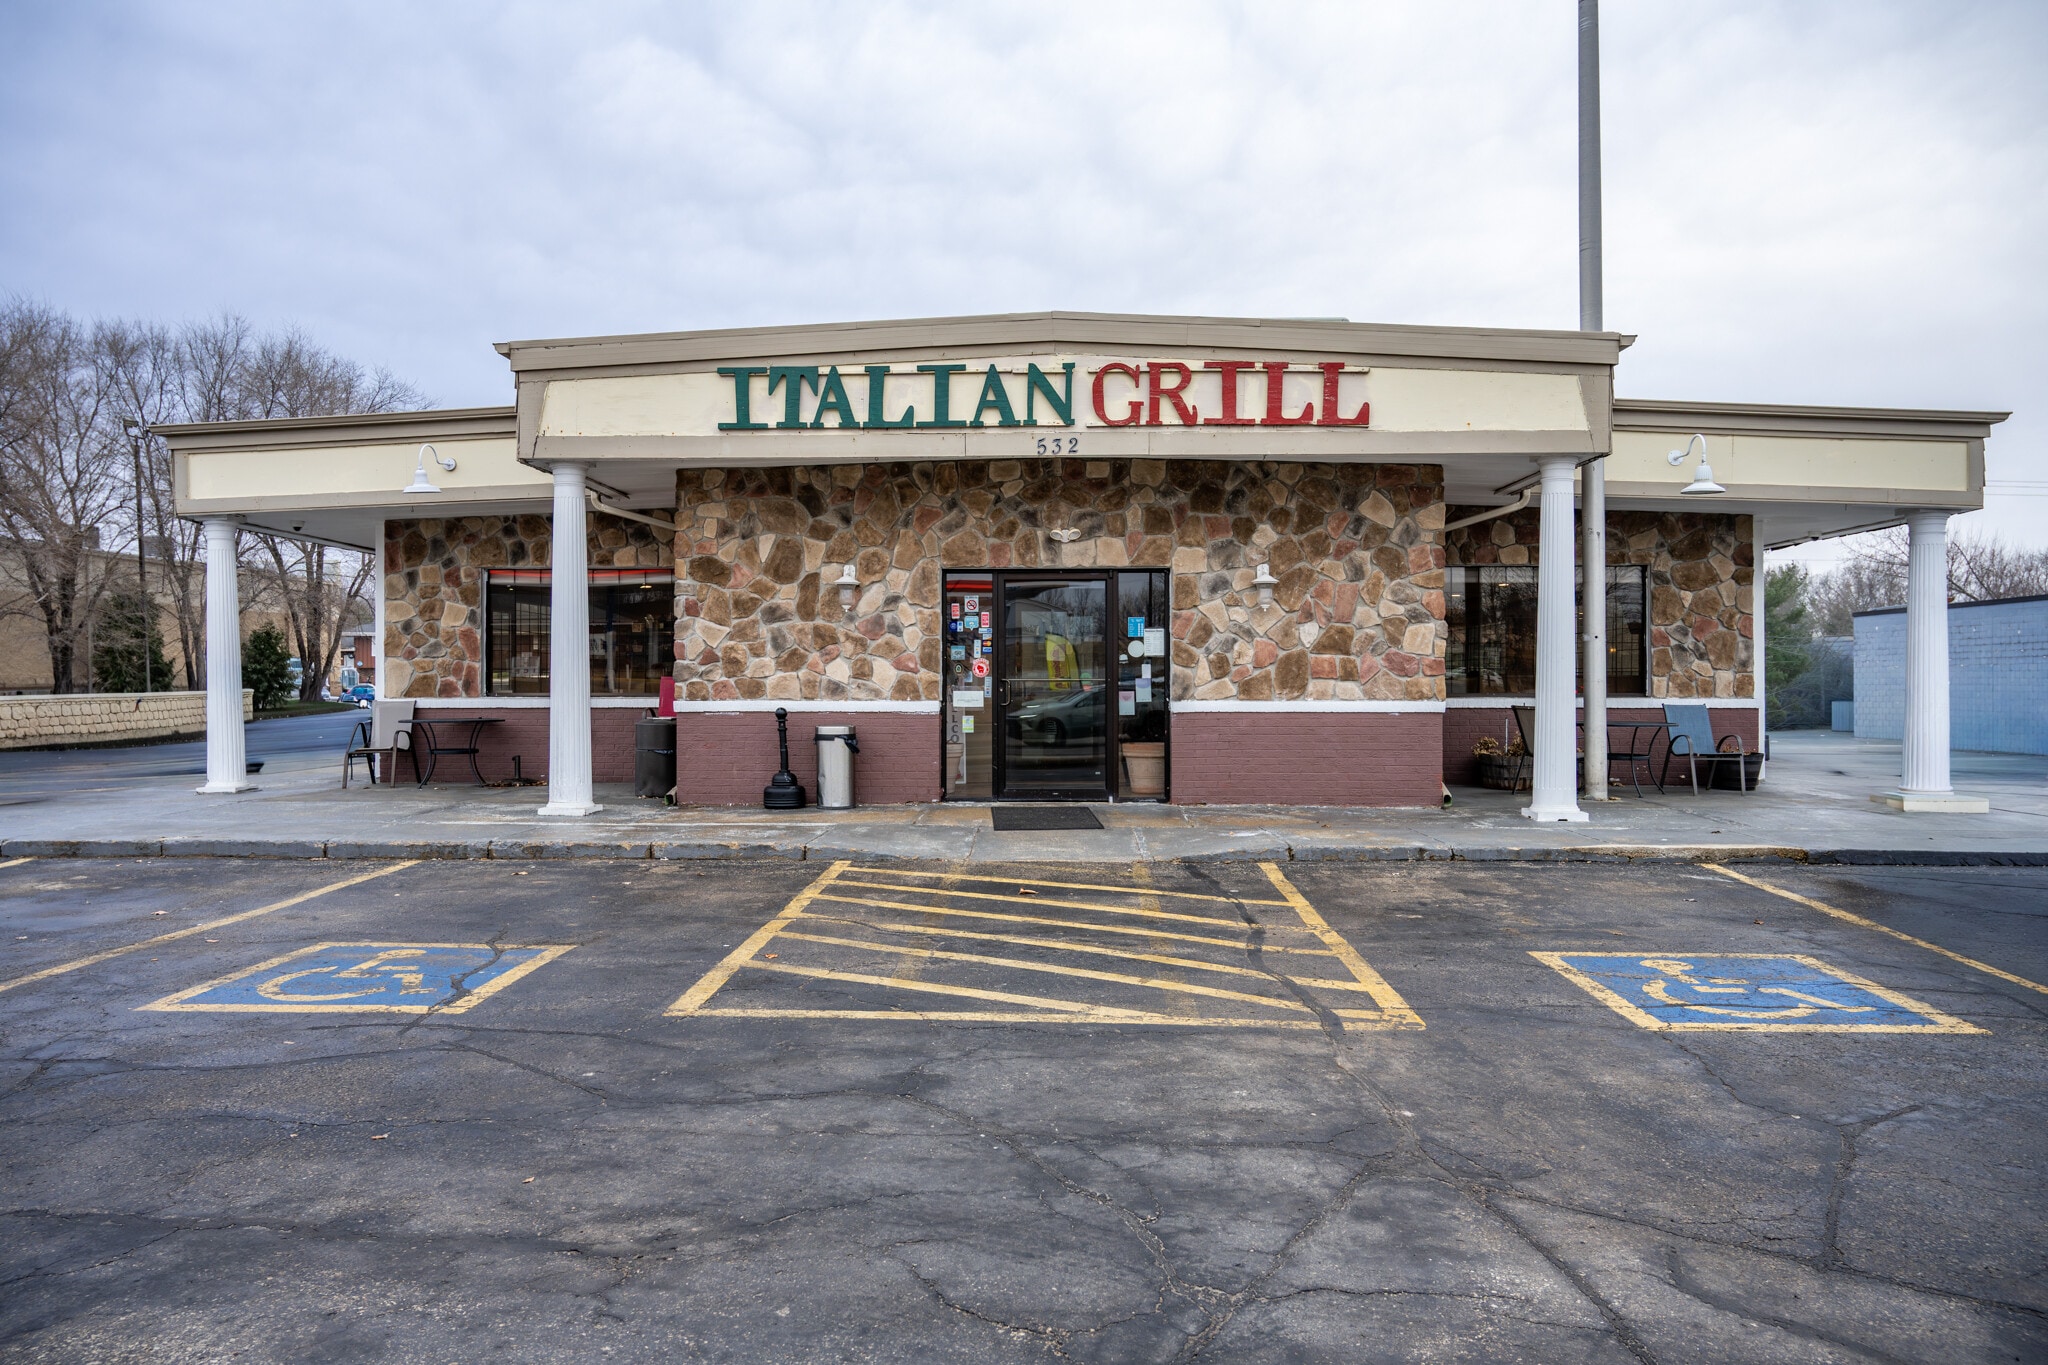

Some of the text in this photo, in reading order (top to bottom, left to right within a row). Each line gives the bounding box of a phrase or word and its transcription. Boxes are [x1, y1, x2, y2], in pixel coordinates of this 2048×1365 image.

[717, 361, 1370, 430] ITALIAN GRILL
[1037, 437, 1078, 455] 532
